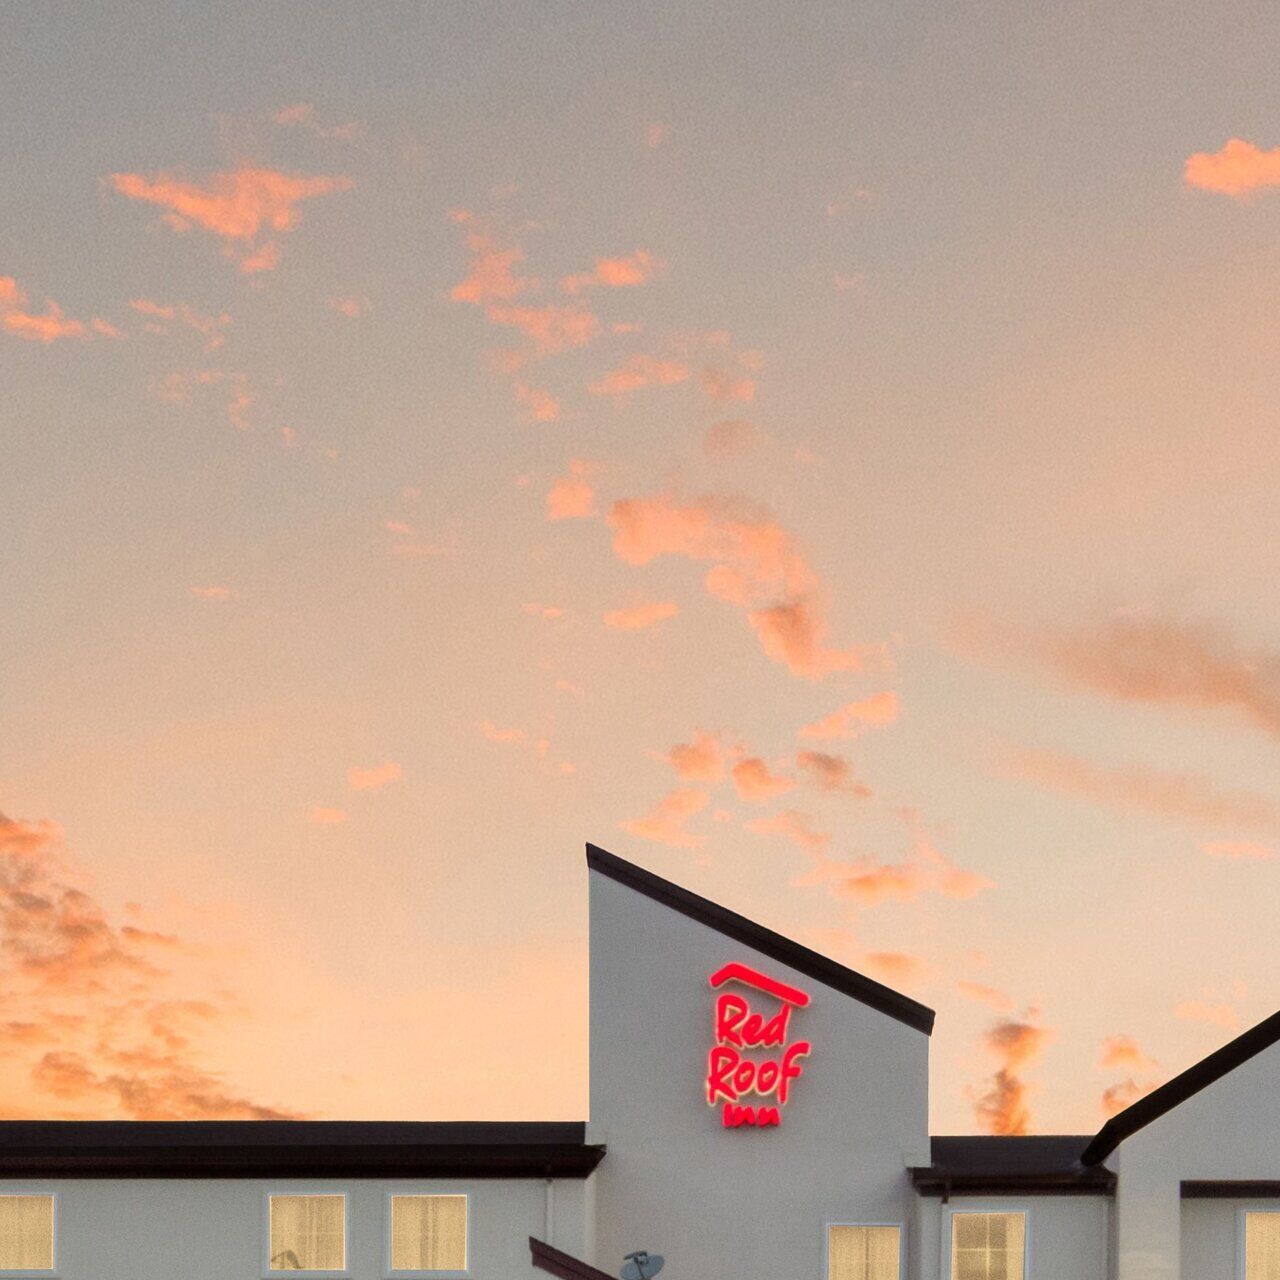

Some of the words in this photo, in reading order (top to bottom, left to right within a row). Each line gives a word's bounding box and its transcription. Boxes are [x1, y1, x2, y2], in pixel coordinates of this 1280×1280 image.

[716, 994, 791, 1047] Red
[706, 1040, 811, 1104] Roof
[722, 1103, 781, 1128] Inn
